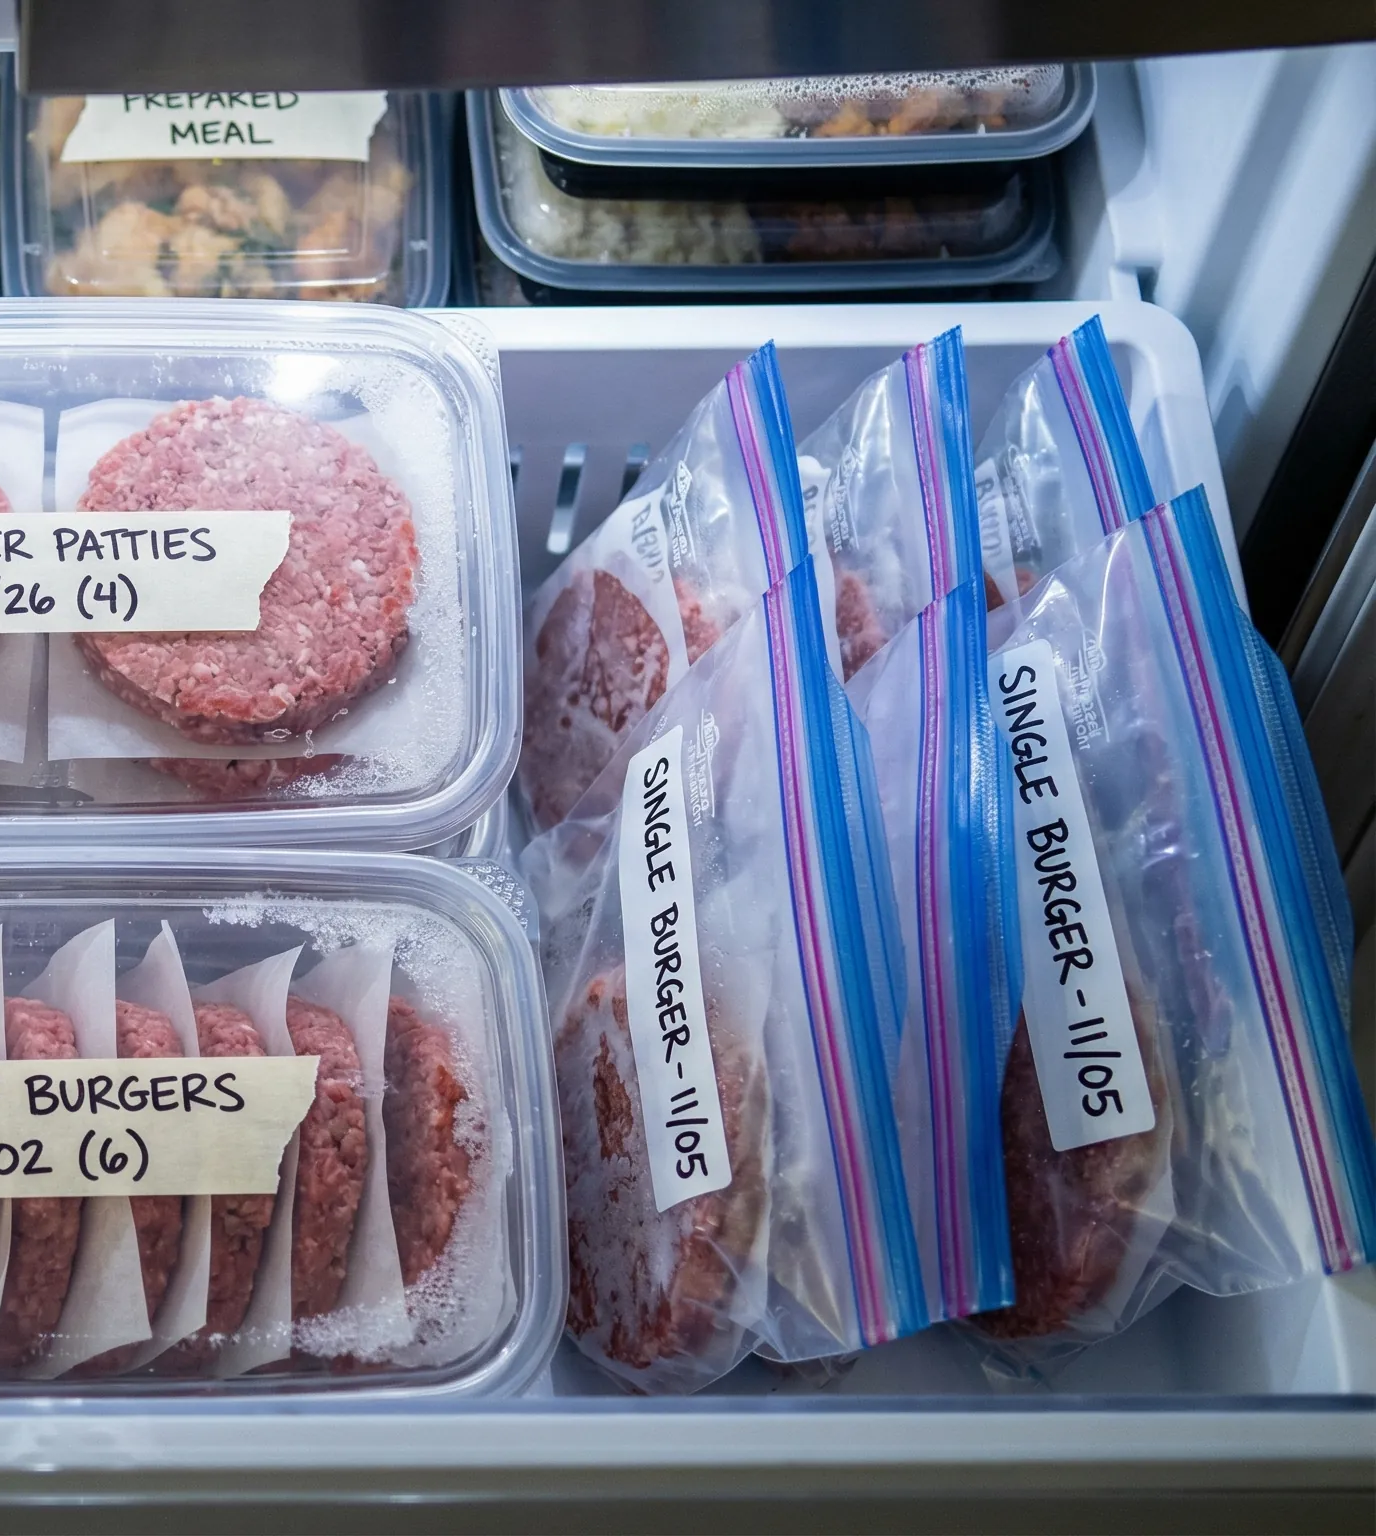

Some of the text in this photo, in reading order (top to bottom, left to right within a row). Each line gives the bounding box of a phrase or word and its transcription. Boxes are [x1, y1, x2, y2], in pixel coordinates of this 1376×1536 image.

[124, 92, 299, 112] PREPARED
[170, 120, 274, 145] MEAL
[53, 527, 217, 563] PATTIES
[76, 573, 139, 622] (4)
[998, 664, 1059, 805] SINGLE
[643, 757, 676, 893] SINGLE
[1027, 817, 1094, 986] BURGER
[24, 1072, 245, 1116] BURGERS
[78, 1127, 149, 1182] (6)
